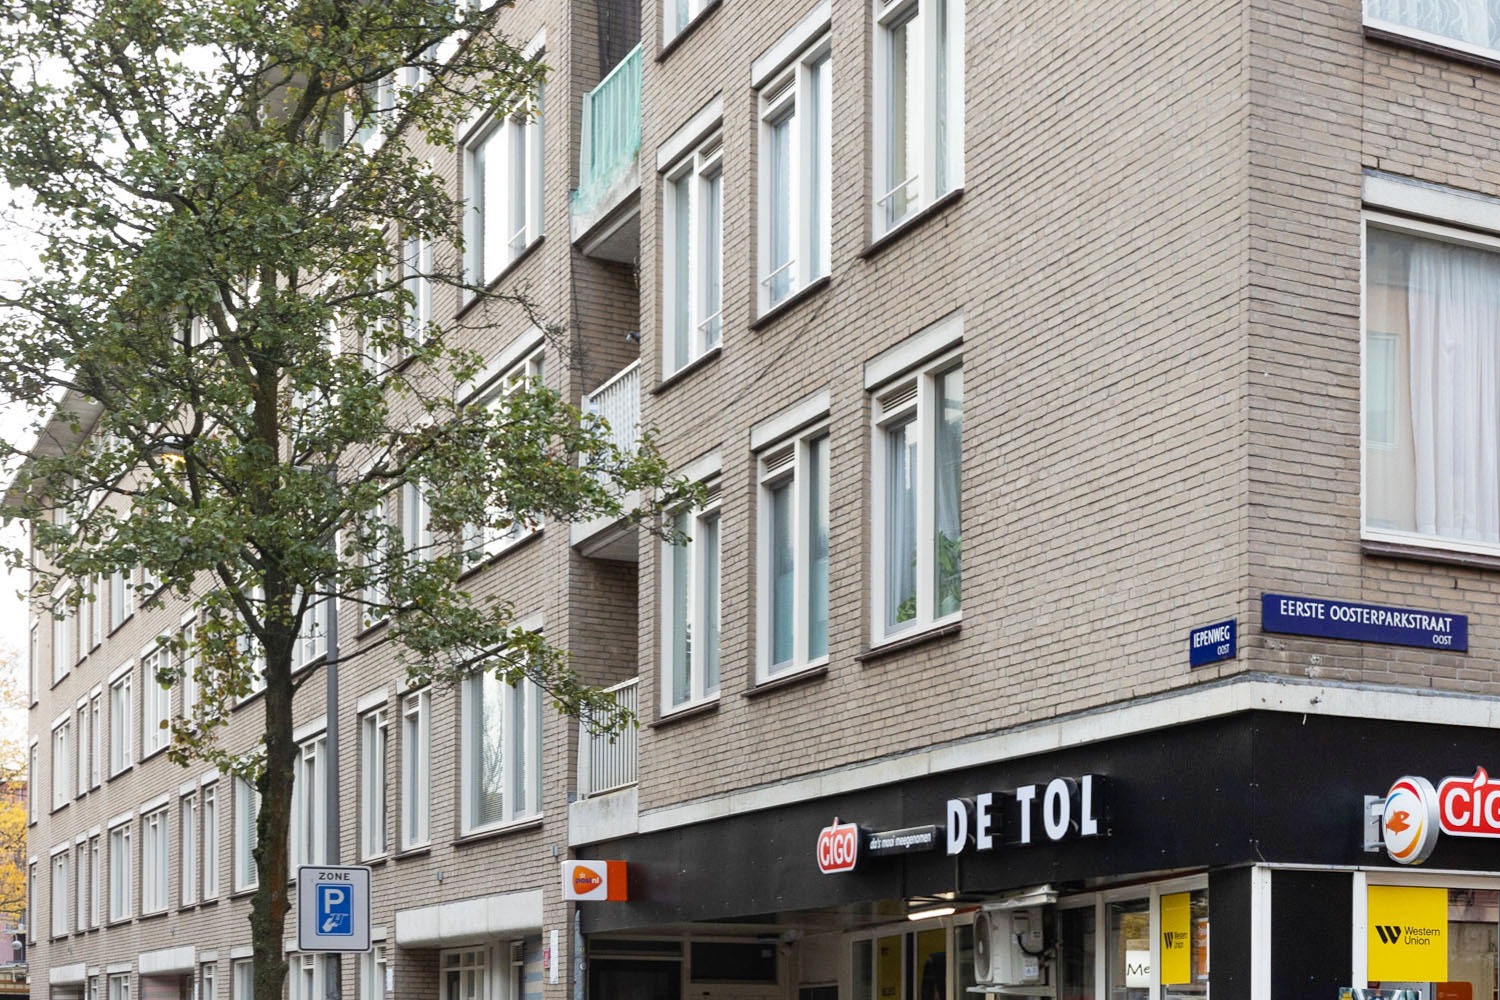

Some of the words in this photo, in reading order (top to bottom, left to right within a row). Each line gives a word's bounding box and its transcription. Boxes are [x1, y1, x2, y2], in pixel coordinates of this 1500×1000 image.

[1280, 599, 1325, 620] EERSTE
[1330, 605, 1452, 633] OOSTERPARKSTRAAT
[1193, 625, 1230, 648] IEPENWEG
[1432, 635, 1452, 646] OOST
[1217, 643, 1230, 656] OOST
[947, 792, 993, 856] DE
[1016, 774, 1098, 844] TOL
[881, 835, 895, 849] mooi
[895, 832, 932, 849] meegenomen
[319, 872, 350, 880] ZONE
[324, 888, 345, 914] P
[1404, 926, 1440, 936] Western
[1404, 936, 1430, 945] Union
